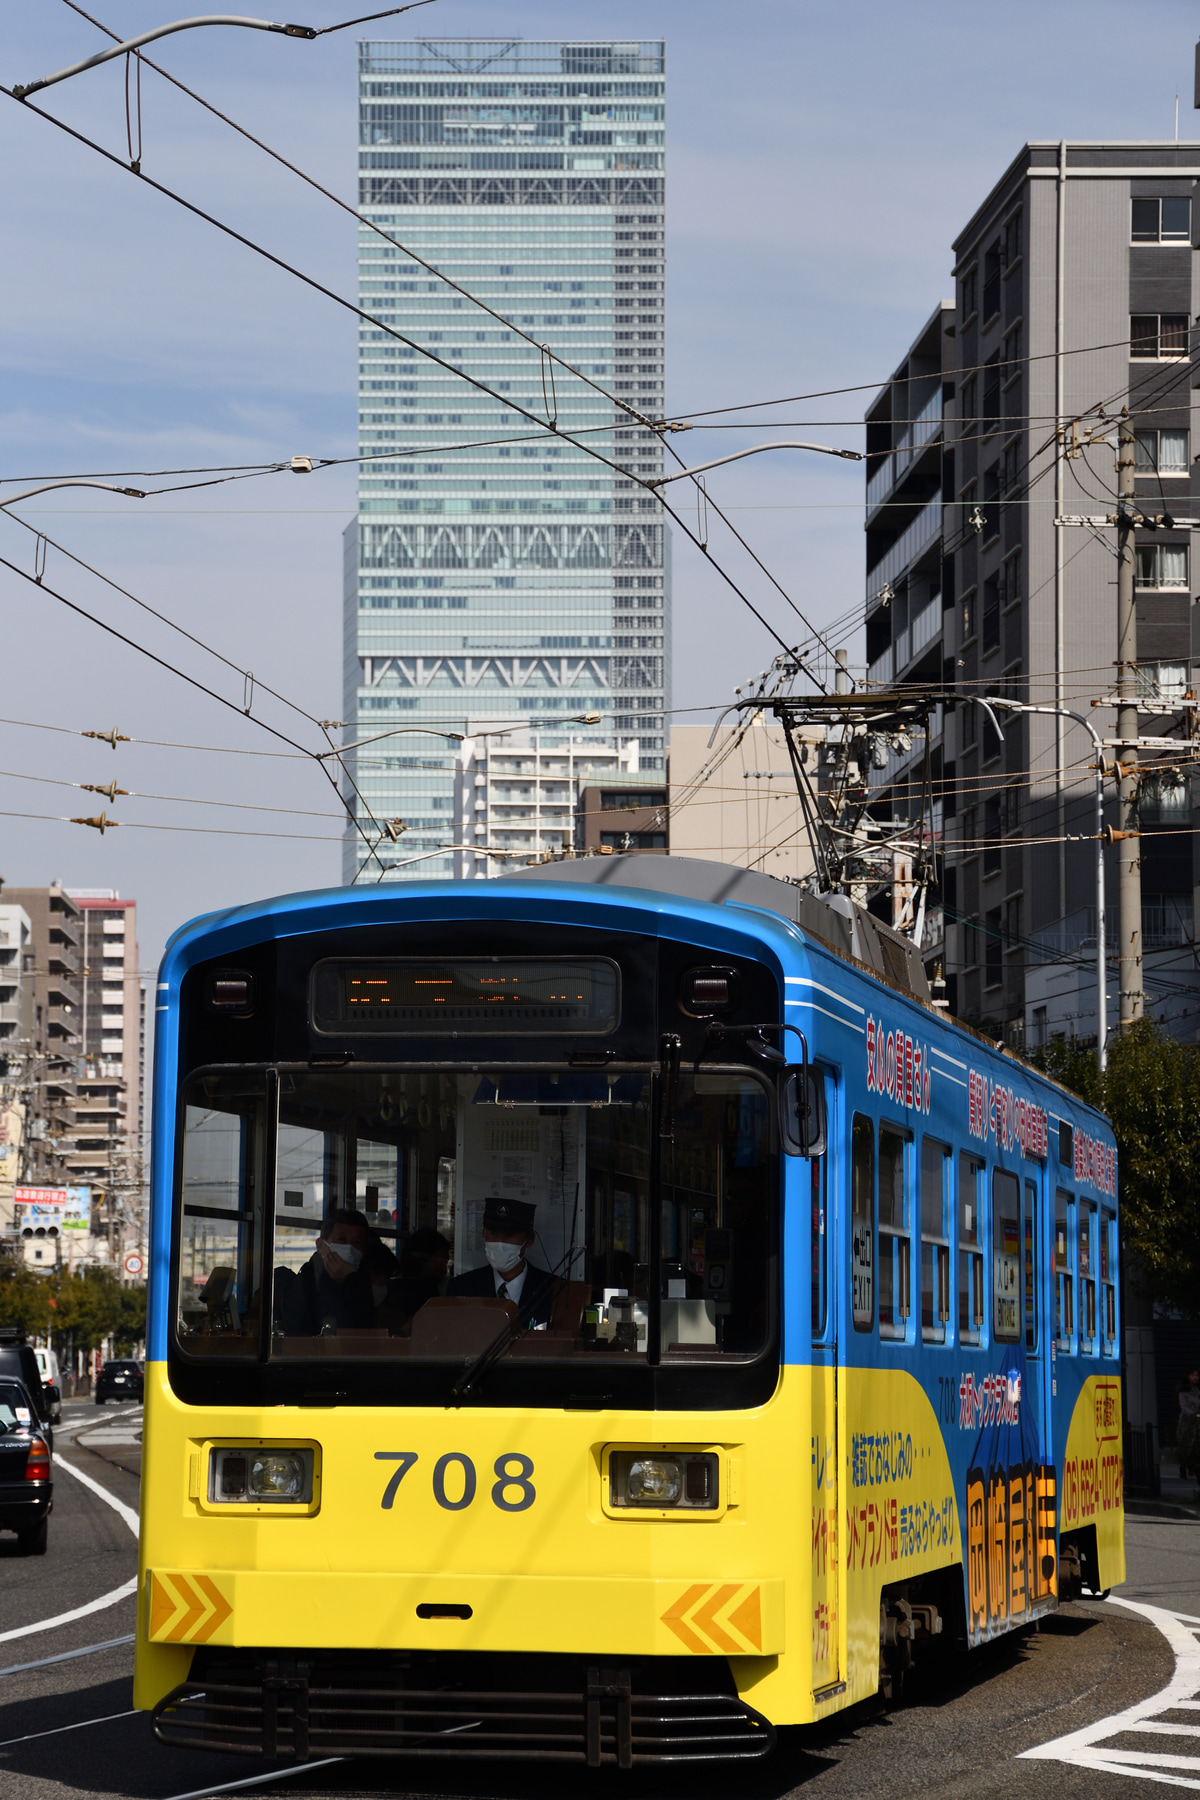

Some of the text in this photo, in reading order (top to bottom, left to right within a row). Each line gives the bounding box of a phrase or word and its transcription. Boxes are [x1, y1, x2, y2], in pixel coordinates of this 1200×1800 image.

[866, 1012, 932, 1116] 安心の質屋さん
[859, 1225, 871, 1267] 出口
[854, 1275, 871, 1311] EXIT
[938, 1377, 956, 1425] 708
[373, 1451, 537, 1512] 708
[900, 1496, 954, 1558] 売るならやっぱり
